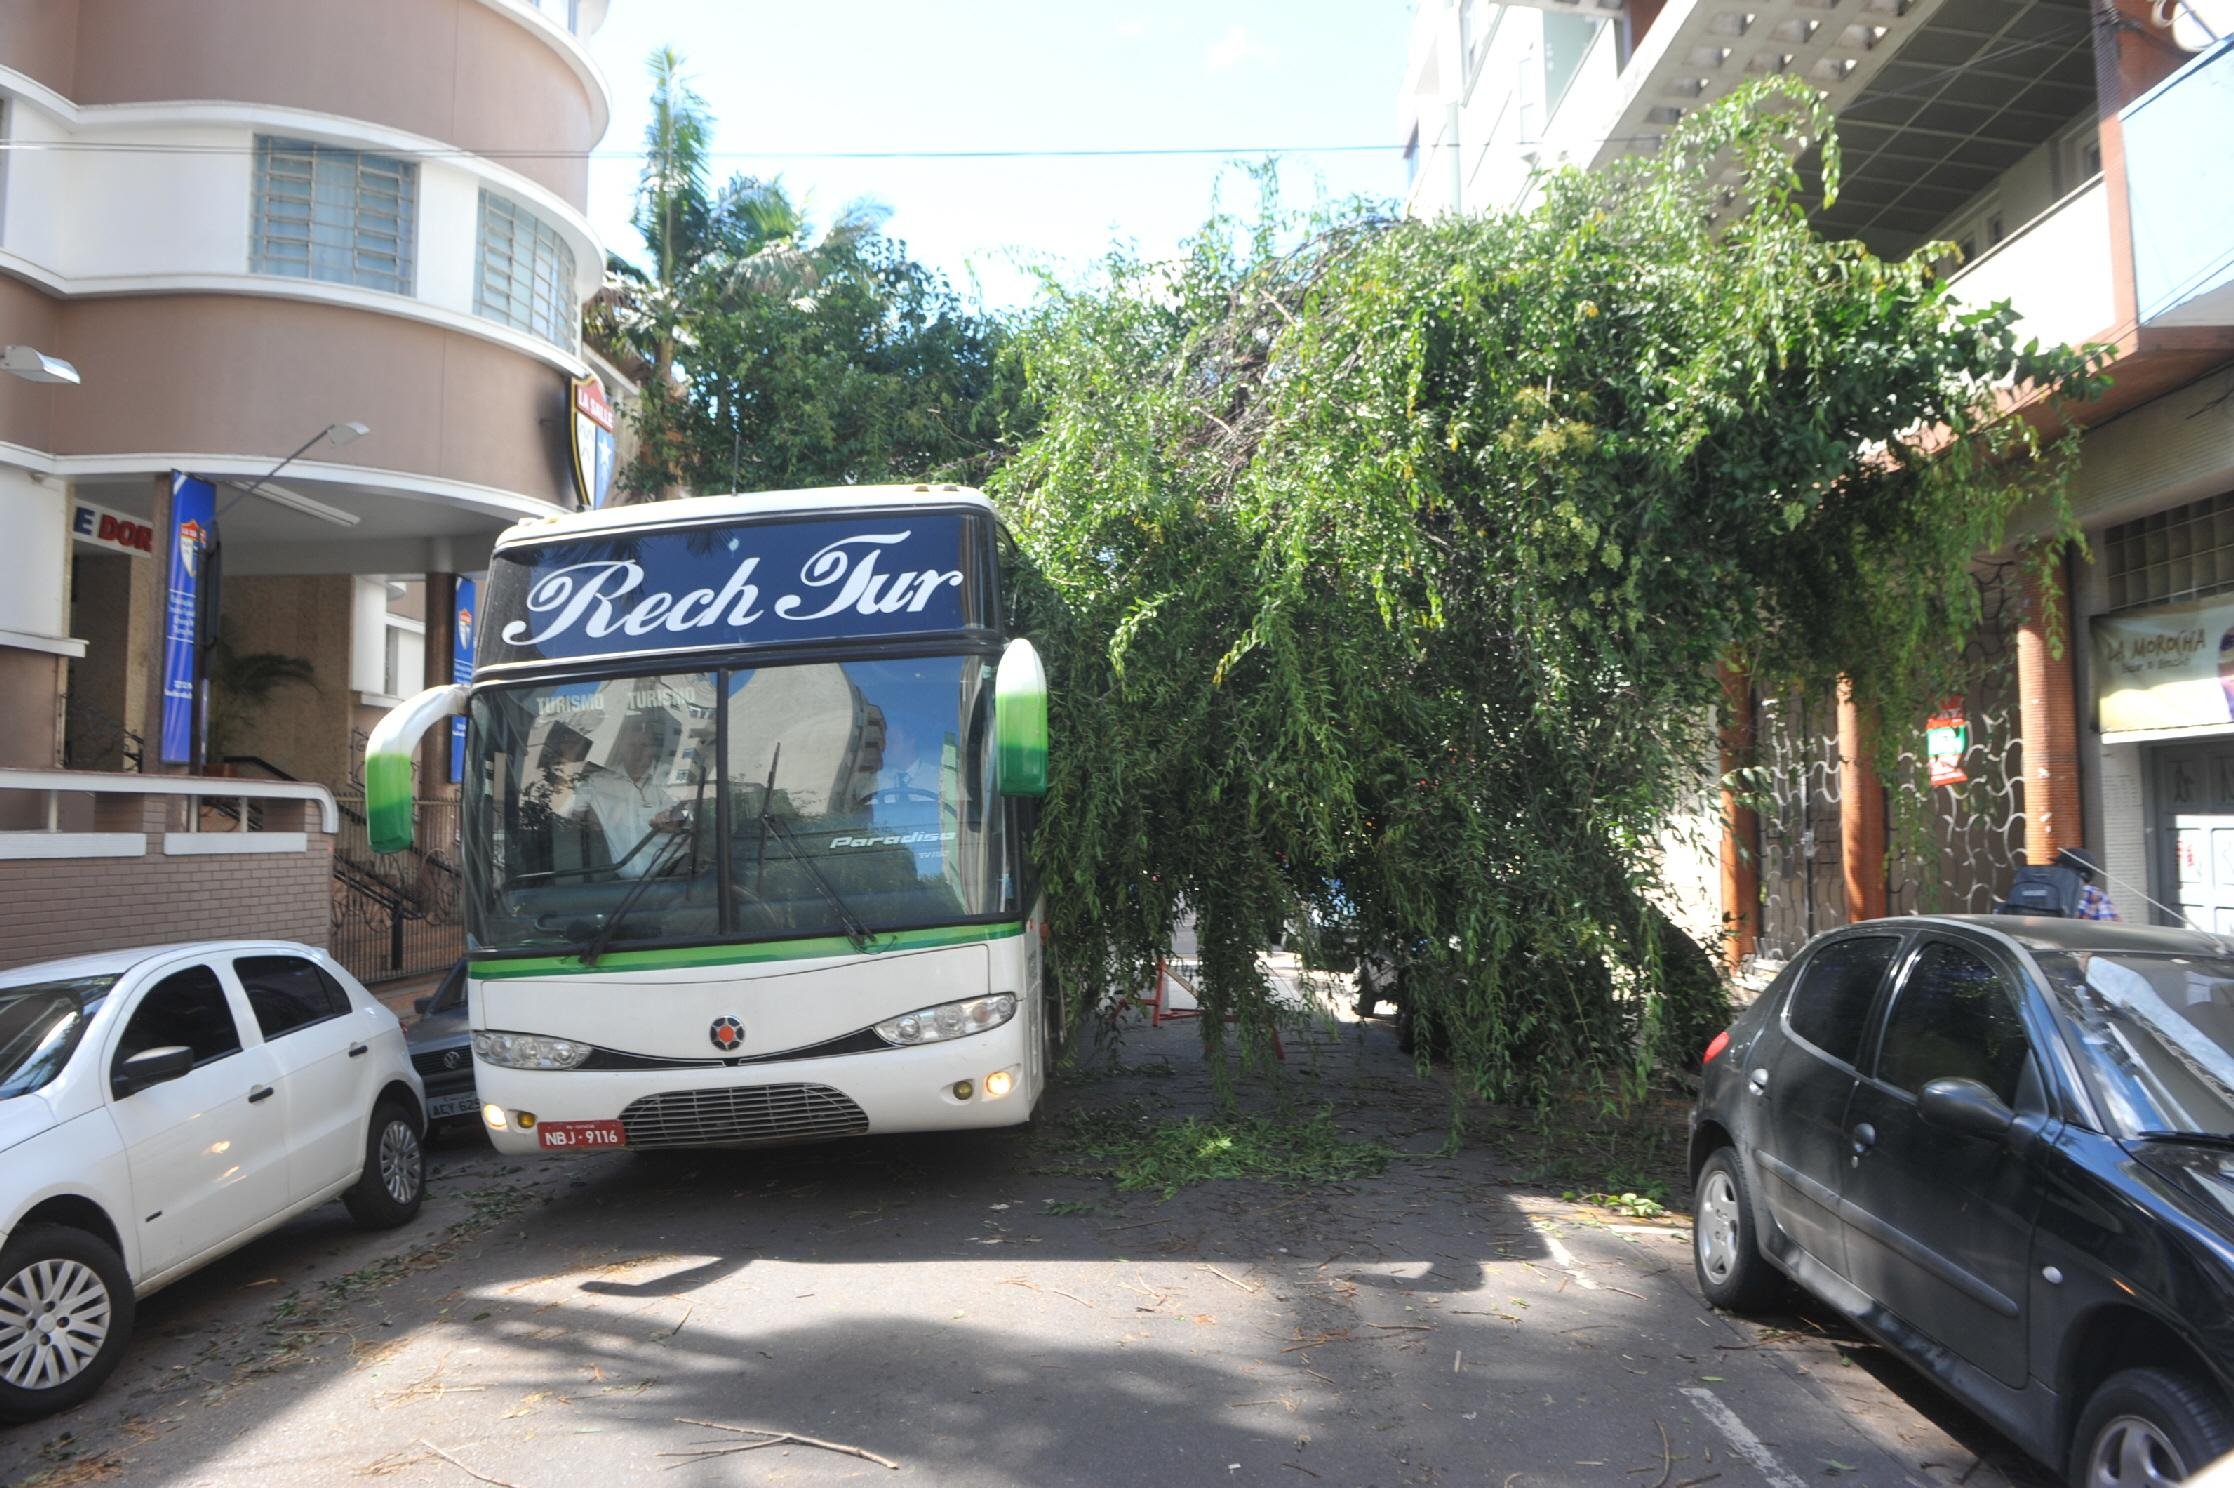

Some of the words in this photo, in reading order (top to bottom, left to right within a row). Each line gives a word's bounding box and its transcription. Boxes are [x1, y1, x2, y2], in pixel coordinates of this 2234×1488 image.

[502, 557, 763, 646] Rech
[775, 530, 963, 621] Tur
[536, 693, 605, 715] TURISMO
[628, 687, 696, 709] TURISMO
[829, 831, 956, 849] Paradiso
